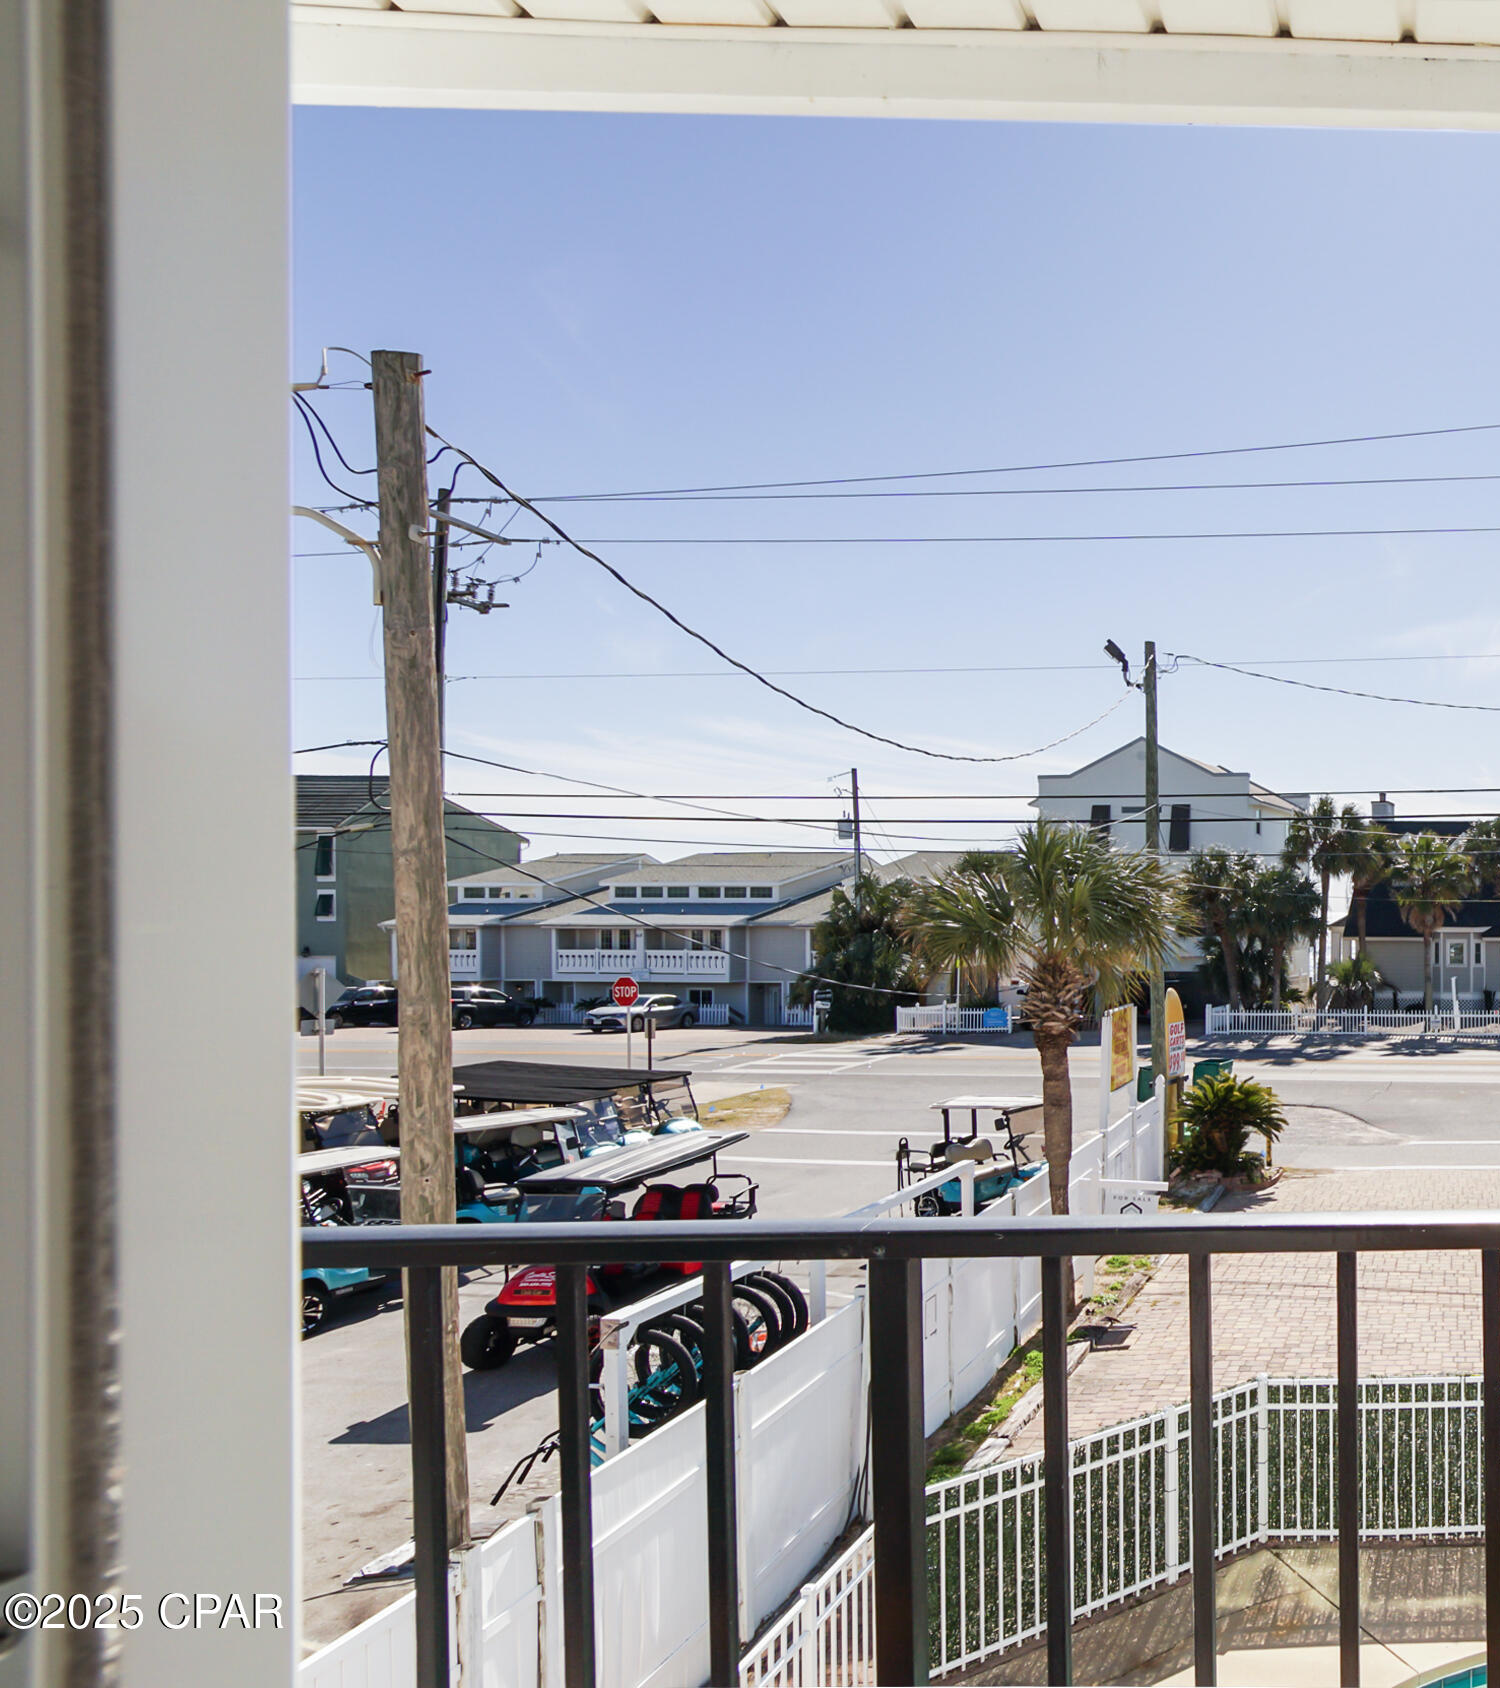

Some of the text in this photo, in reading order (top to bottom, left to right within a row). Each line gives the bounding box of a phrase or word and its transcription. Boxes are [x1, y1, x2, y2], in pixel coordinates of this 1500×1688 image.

[614, 986, 637, 998] STOP
[1170, 1023, 1184, 1036] GOLF
[1170, 1035, 1185, 1047] CARTS
